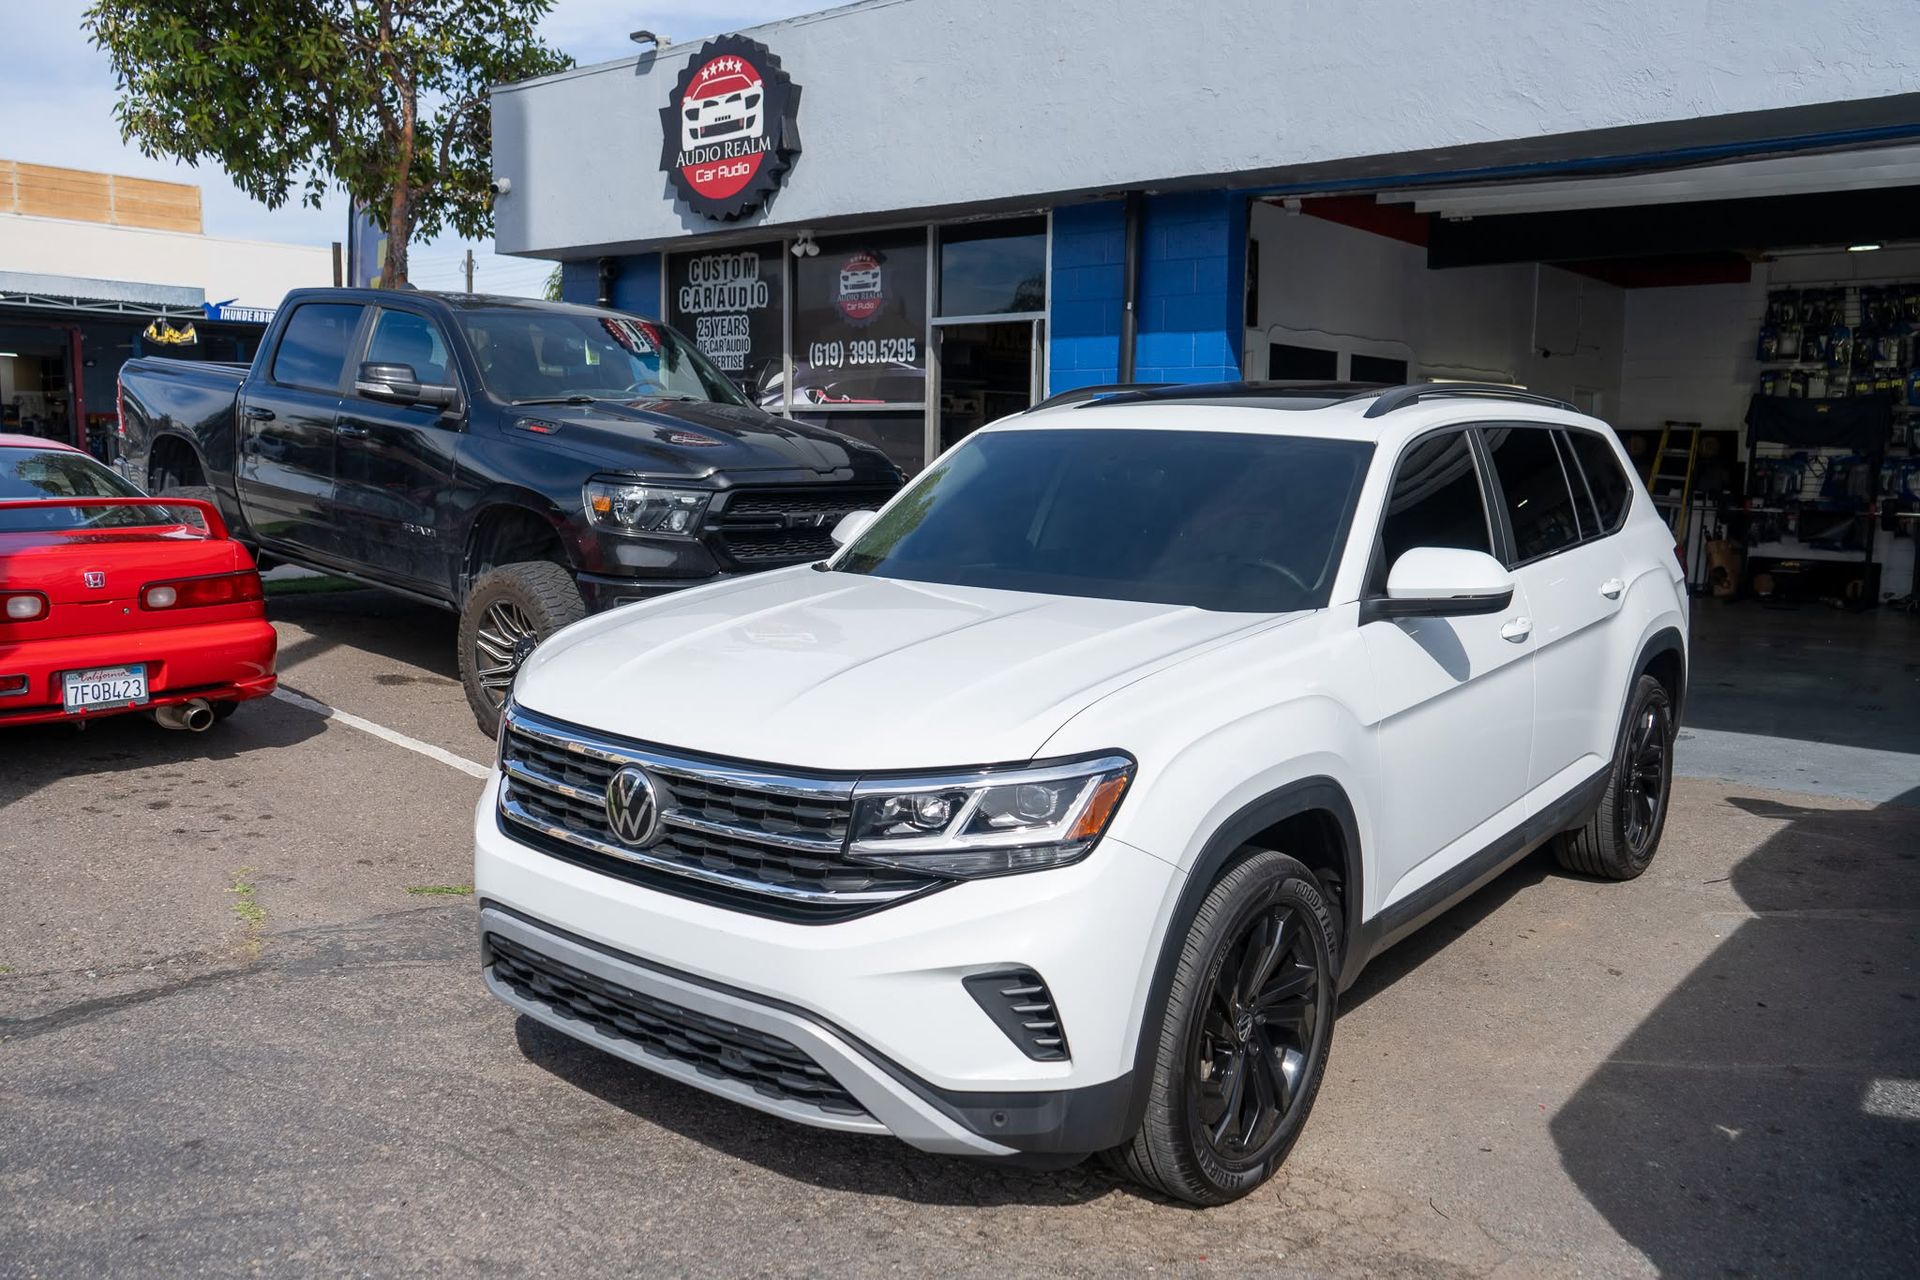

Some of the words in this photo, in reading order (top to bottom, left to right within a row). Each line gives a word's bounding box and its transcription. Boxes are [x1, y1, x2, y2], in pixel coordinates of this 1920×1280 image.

[675, 145, 721, 168] AUDIO
[724, 135, 772, 159] REALM
[695, 167, 716, 183] Car
[717, 162, 750, 179] Audio
[689, 255, 758, 283] CUSTOM
[681, 286, 714, 312] CAR
[715, 282, 768, 310] AUDIO
[697, 318, 711, 338] 25
[712, 316, 749, 338] YEARS
[698, 339, 708, 353] OF
[709, 338, 724, 353] CAR
[725, 337, 750, 353] AUDIO
[809, 340, 844, 369] (619)
[849, 337, 916, 365] 399.5295
[710, 354, 743, 369] PERTISE
[80, 669, 130, 683] California
